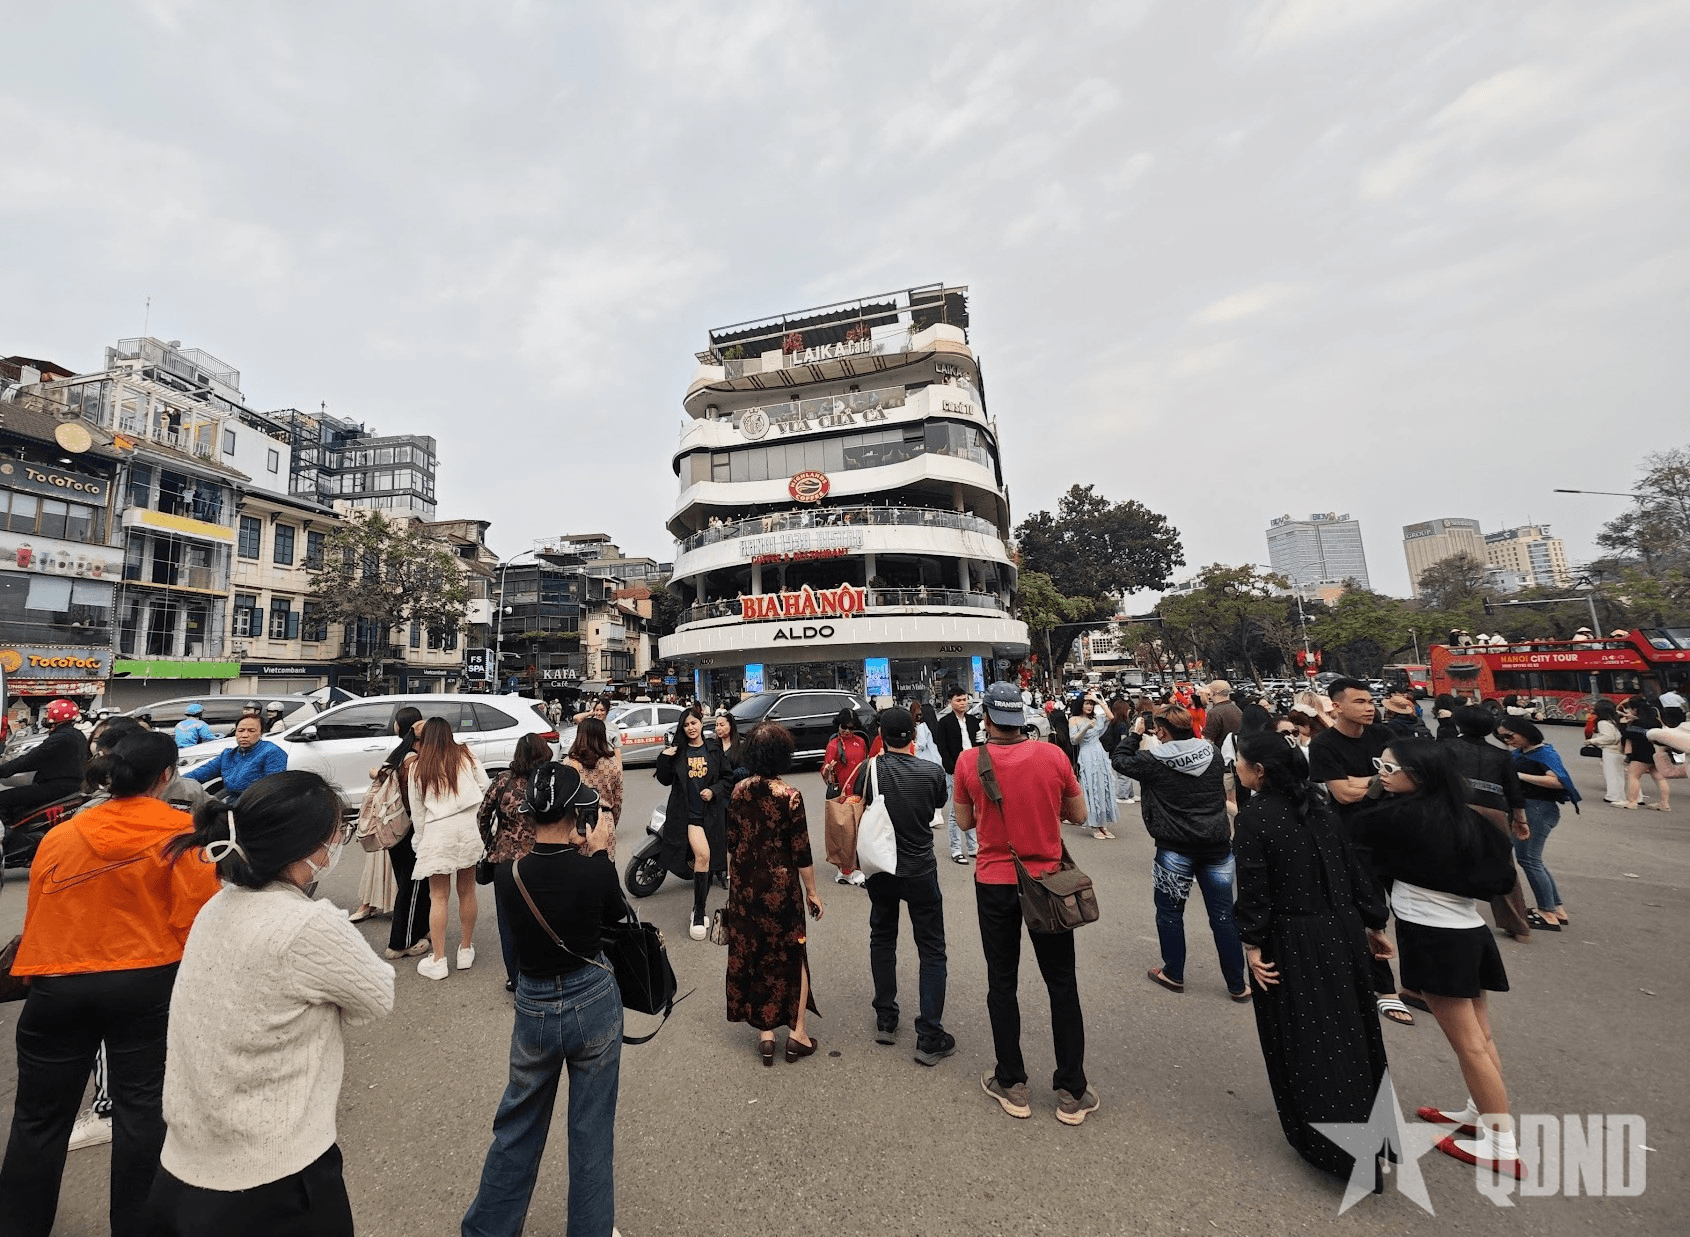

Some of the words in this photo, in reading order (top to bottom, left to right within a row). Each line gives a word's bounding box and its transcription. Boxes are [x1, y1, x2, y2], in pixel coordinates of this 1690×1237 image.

[793, 341, 846, 365] LAIKA
[848, 337, 870, 355] Café
[935, 362, 962, 377] LAIKA
[776, 418, 812, 434] VUA
[790, 472, 828, 488] HIGHLANDS
[795, 491, 825, 501] COFFEE
[1406, 529, 1432, 539] GROUP
[780, 532, 811, 552] 1930
[793, 547, 849, 561] RESTAURANT
[742, 595, 780, 619] BIA
[783, 586, 818, 617] HÀ
[820, 585, 866, 619] NỘI
[773, 625, 835, 641] ALDO
[940, 645, 963, 653] ALDO
[470, 655, 483, 664] FS
[1530, 654, 1551, 663] CITY
[1552, 653, 1579, 662] TOUR
[263, 666, 307, 674] Vietcombank
[468, 664, 485, 673] SPA
[543, 668, 577, 680] KAFA
[551, 680, 569, 688] Café
[688, 756, 708, 767] FEEL
[688, 767, 708, 778] GOOD
